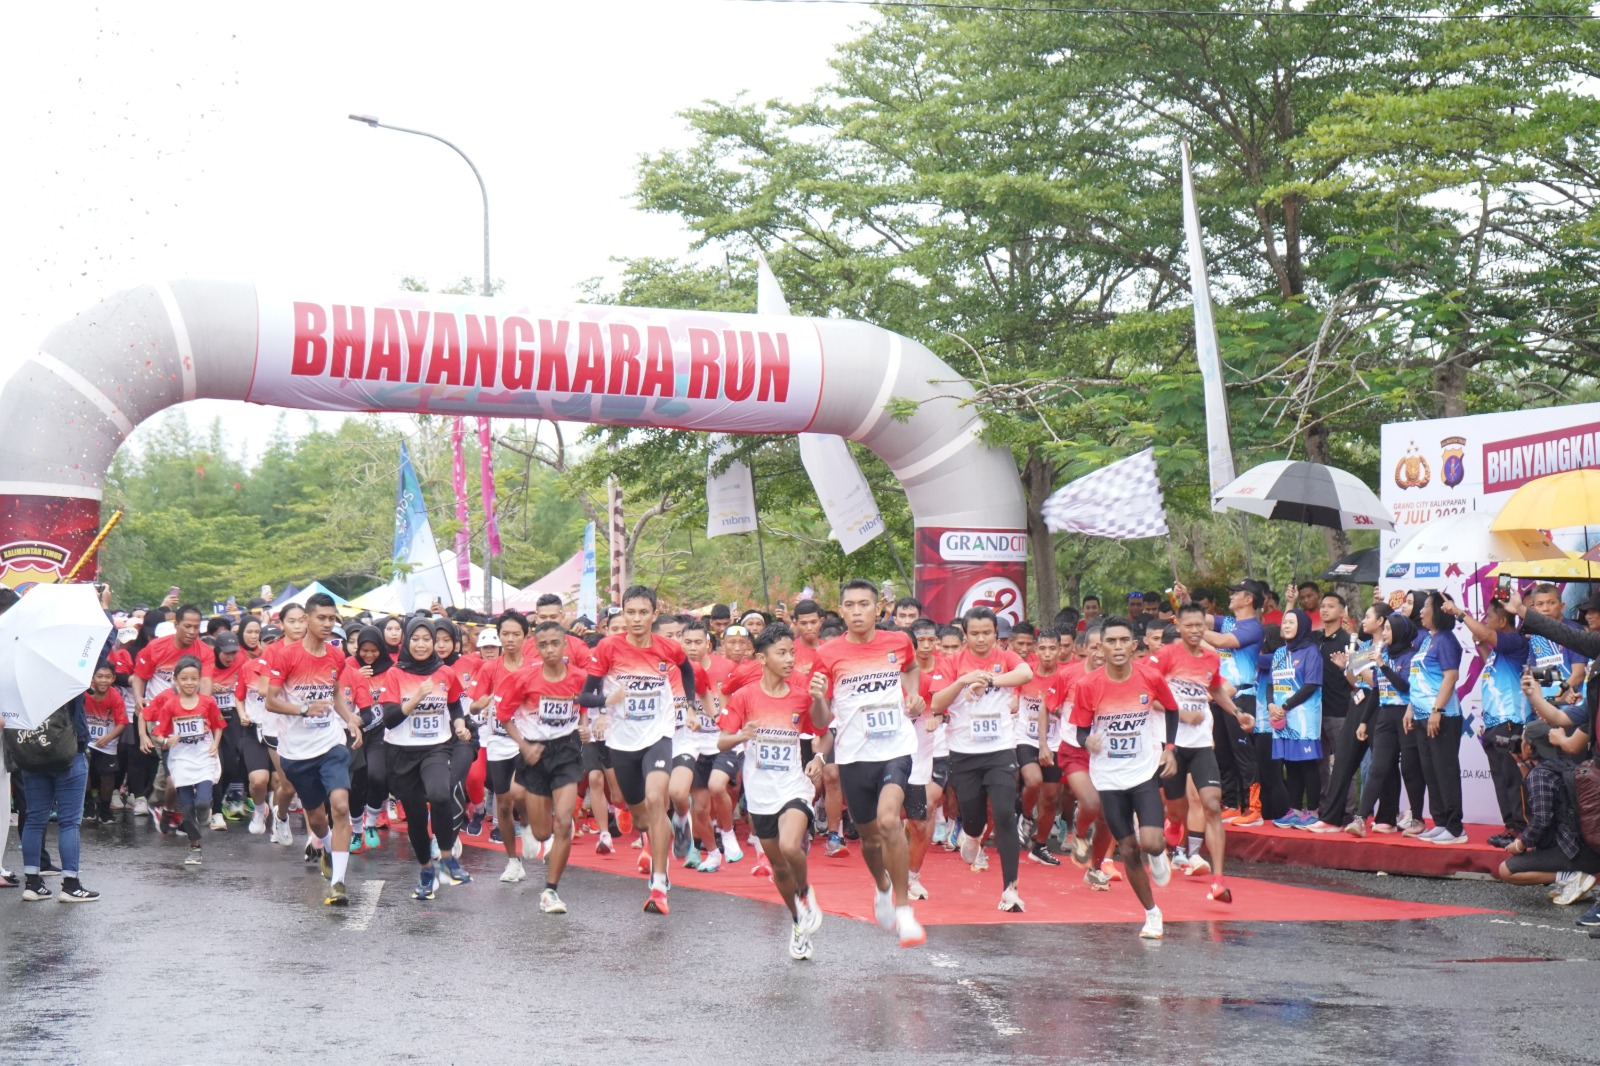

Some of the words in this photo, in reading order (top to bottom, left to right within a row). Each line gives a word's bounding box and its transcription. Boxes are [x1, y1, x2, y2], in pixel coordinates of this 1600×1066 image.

[291, 300, 675, 399] BHAYANGKARA
[686, 327, 791, 403] RUN
[1393, 502, 1415, 510] GRAND
[1429, 498, 1467, 508] BALIKPAPAN
[1393, 511, 1402, 524] 7
[1403, 509, 1431, 525] JULI
[1416, 565, 1439, 575] ISOPLUS
[81, 635, 95, 658] gopay
[543, 702, 569, 715] 1253
[628, 698, 655, 712] 344
[1, 711, 20, 719] gopay
[866, 710, 894, 728] 501
[176, 720, 198, 733] 1116
[413, 716, 439, 730] 055
[973, 719, 998, 733] 595
[1110, 736, 1136, 751] 927
[759, 744, 791, 761] 532
